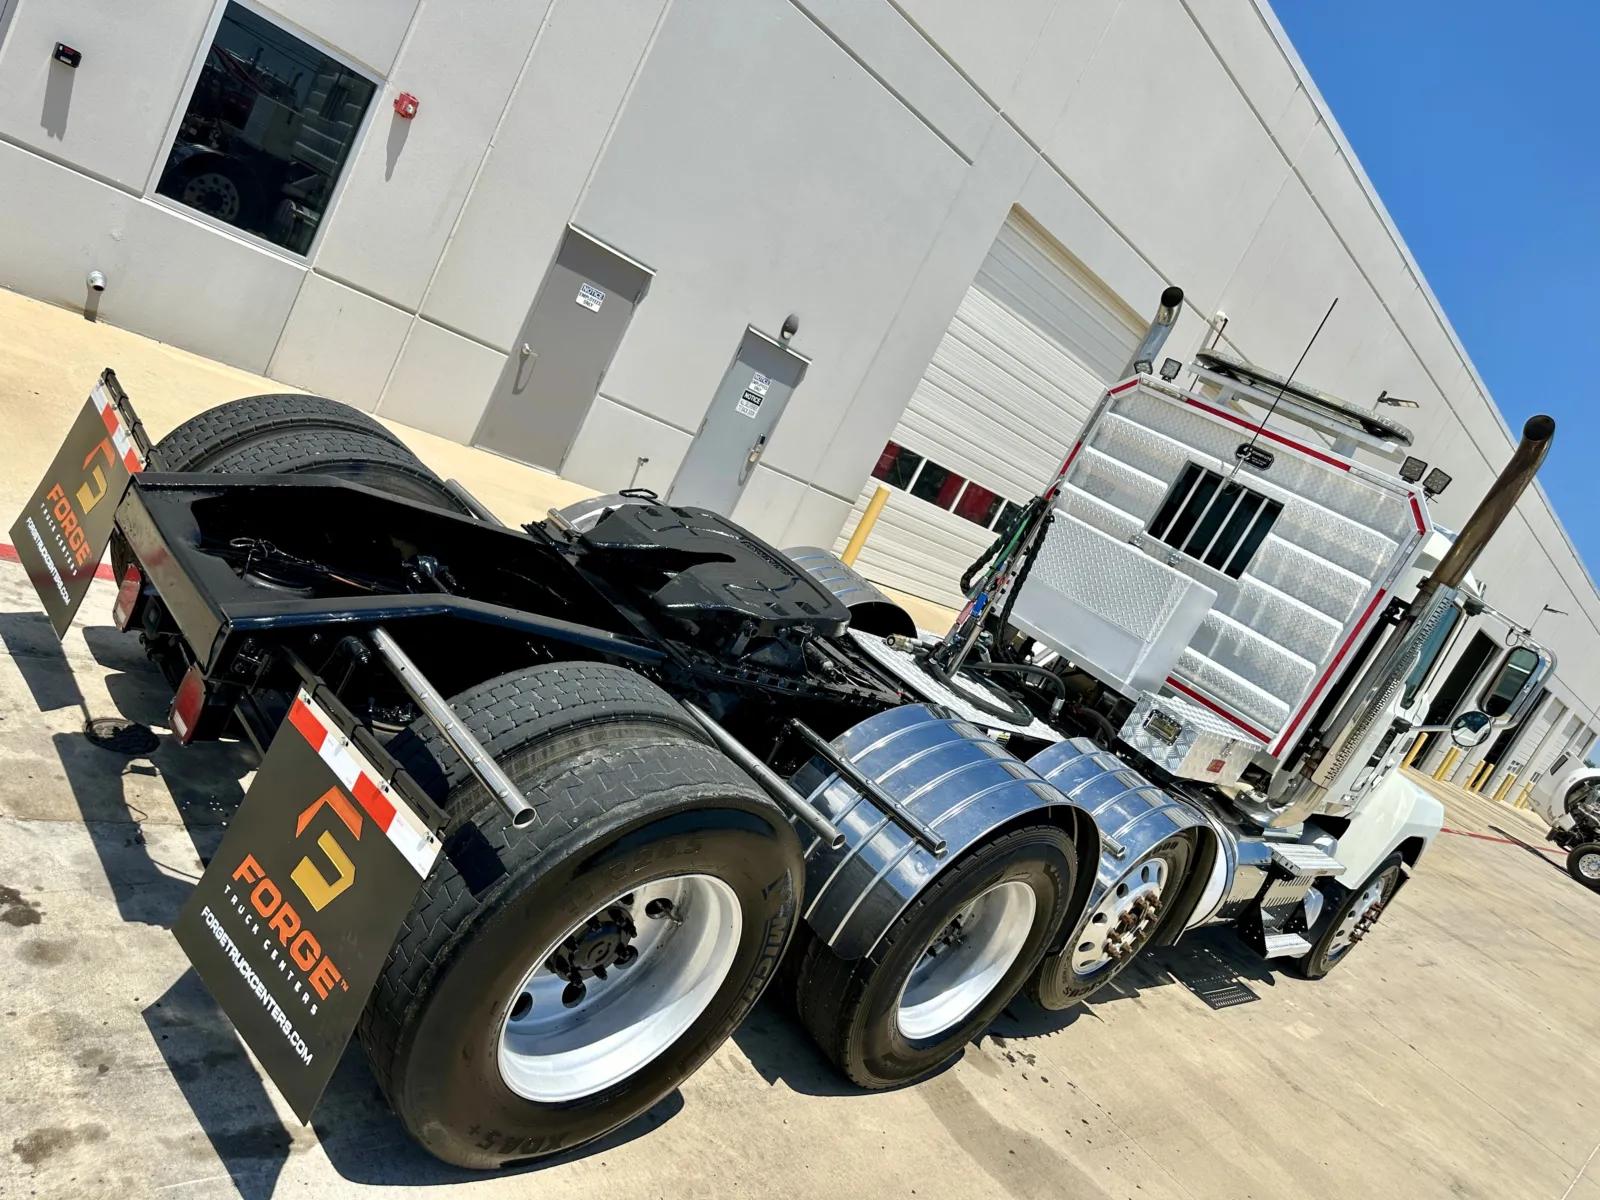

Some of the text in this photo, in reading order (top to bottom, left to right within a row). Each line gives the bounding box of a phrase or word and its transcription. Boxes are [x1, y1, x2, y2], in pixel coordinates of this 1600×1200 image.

[581, 284, 605, 301] NOTICE
[743, 391, 762, 405] NOTICE
[41, 502, 56, 533] TRUCK
[46, 482, 91, 566] FORGE
[224, 883, 318, 1016] TRUCK CENTERS
[232, 853, 341, 1001] FORGE
[201, 906, 314, 1067] FORGETRUCKCENTERS.COM
